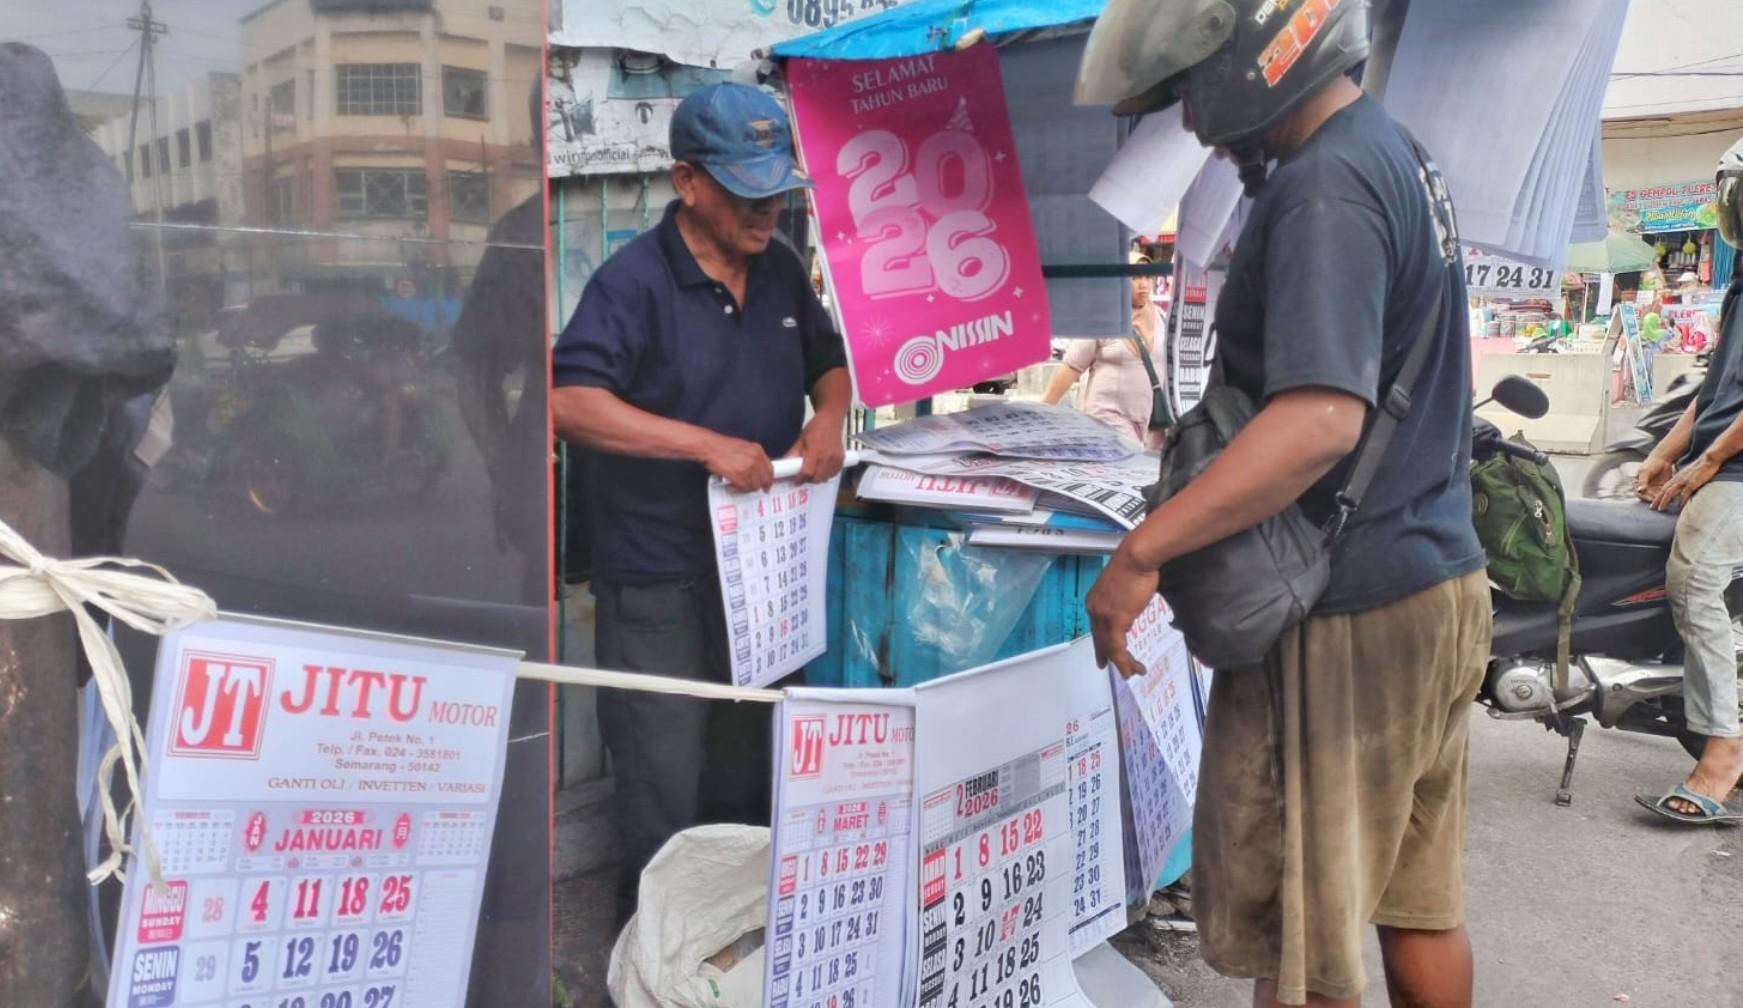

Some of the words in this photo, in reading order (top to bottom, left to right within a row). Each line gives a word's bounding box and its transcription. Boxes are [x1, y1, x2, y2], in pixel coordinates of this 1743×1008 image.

[852, 54, 936, 93] SELAMAT
[852, 89, 904, 114] TAHUN
[907, 75, 949, 100] BARU
[1466, 263, 1491, 287] 17
[1496, 265, 1524, 288] 24
[1528, 267, 1554, 289] 31
[935, 309, 1014, 351] NISSIN
[772, 495, 784, 514] 11
[759, 525, 767, 543] 5
[774, 520, 785, 539] 12
[776, 545, 787, 565] 13
[778, 570, 788, 589] 14
[767, 600, 775, 618] 8
[179, 663, 263, 748] JT
[280, 664, 427, 723] JITU
[428, 701, 498, 728] MOTOR
[368, 732, 402, 744] Petek
[406, 733, 424, 745] No.
[829, 713, 890, 747] JITU
[335, 758, 398, 773] Semarang
[268, 776, 317, 791] GANTI
[320, 778, 346, 791] OLI
[357, 779, 428, 792] INVETTEN
[437, 782, 487, 794] VARIASI
[956, 784, 965, 817] 2
[965, 769, 999, 800] FEBRUARI
[1078, 781, 1088, 801] 19
[1091, 773, 1101, 794] 26
[311, 811, 355, 824] 2026
[965, 788, 999, 818] 2026
[1077, 804, 1088, 826] 20
[1091, 796, 1101, 816] 27
[833, 814, 870, 832] MARET
[274, 828, 384, 852] JANUARI
[954, 847, 963, 880] 1
[978, 832, 990, 867] 8
[1001, 818, 1019, 857] 15
[1023, 809, 1042, 844] 22
[803, 855, 809, 882] 1
[820, 851, 829, 877] 8
[836, 848, 849, 873] 15
[854, 845, 870, 870] 22
[872, 842, 887, 866] 29
[1088, 863, 1101, 886] 30
[202, 896, 224, 923] 28
[251, 880, 270, 922] 4
[293, 878, 323, 919] 11
[337, 876, 369, 916] 18
[379, 875, 413, 913] 25
[800, 893, 808, 920] 2
[818, 888, 826, 914] 9
[833, 884, 845, 910] 16
[851, 879, 865, 905] 23
[869, 875, 883, 901] 30
[954, 892, 965, 926] 2
[981, 878, 992, 911] 9
[1003, 862, 1022, 900] 16
[1026, 850, 1046, 887] 23
[1074, 896, 1086, 917] 24
[1090, 888, 1101, 908] 31
[141, 915, 181, 929] SUNDAY
[798, 932, 805, 959] 3
[814, 926, 826, 954] 10
[831, 920, 843, 948] 17
[847, 915, 861, 942] 24
[865, 911, 879, 936] 31
[953, 937, 965, 972] 3
[975, 919, 995, 958] 10
[1000, 903, 1021, 943] 17
[1023, 891, 1043, 928] 24
[134, 951, 179, 982] SENIN
[194, 955, 216, 982] 29
[241, 941, 262, 983] 5
[282, 937, 315, 979] 12
[327, 933, 360, 974] 19
[370, 930, 403, 970] 26
[969, 962, 988, 1001] 11
[995, 946, 1016, 984] 18
[1020, 931, 1040, 969] 25
[132, 981, 174, 996] MONDAY
[795, 970, 803, 998] 4
[811, 964, 822, 992] 11
[828, 958, 840, 985] 18
[844, 952, 858, 978] 25
[1019, 972, 1041, 1008] 26
